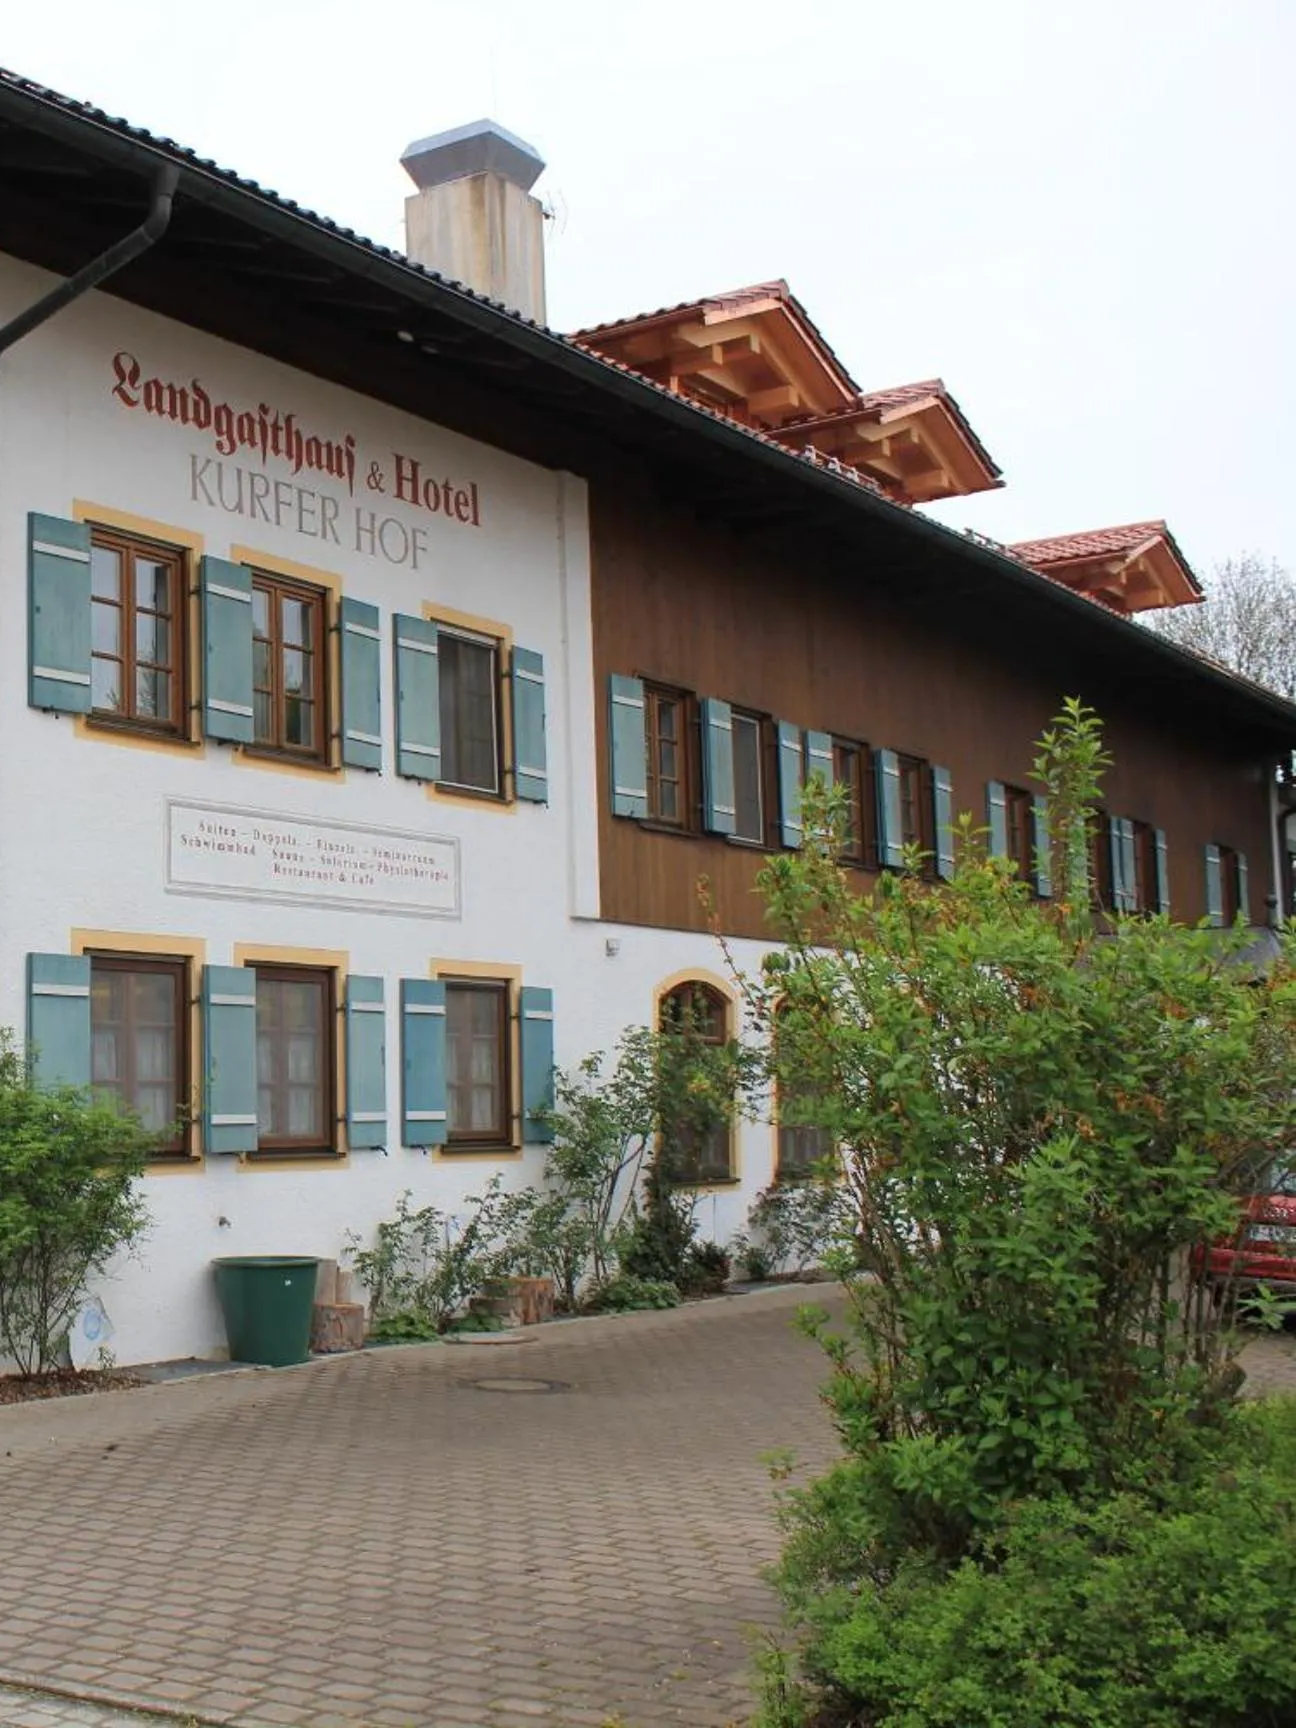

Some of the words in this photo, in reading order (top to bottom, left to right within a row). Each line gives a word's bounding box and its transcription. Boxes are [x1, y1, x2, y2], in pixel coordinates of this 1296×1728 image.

[188, 453, 341, 545] KURFER
[355, 507, 429, 569] HOF
[366, 461, 385, 493] &
[392, 452, 481, 526] Hotel
